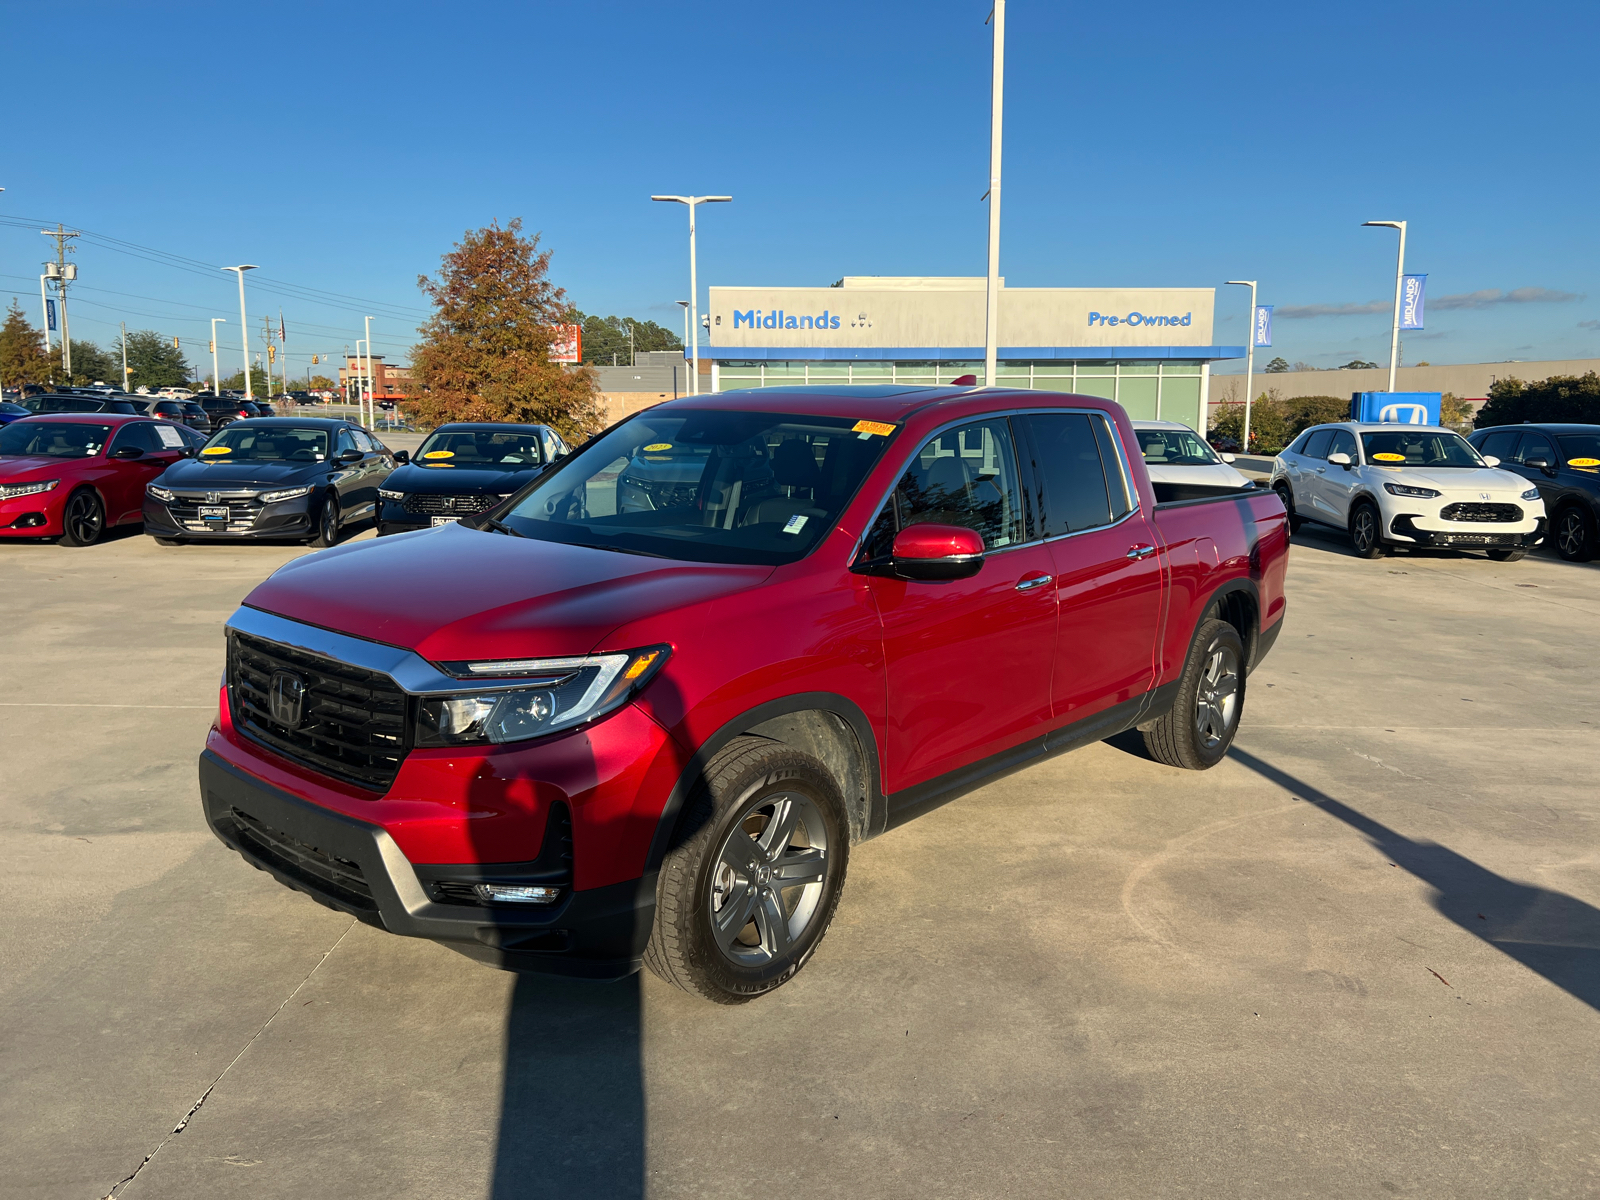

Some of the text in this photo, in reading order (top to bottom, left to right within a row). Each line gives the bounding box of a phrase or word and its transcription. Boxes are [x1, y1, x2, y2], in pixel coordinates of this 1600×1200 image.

[1404, 278, 1416, 325] MIDLANDS
[733, 309, 841, 330] Midlands
[1088, 311, 1192, 327] Pre-Owned
[1257, 308, 1266, 343] MIDLANDS
